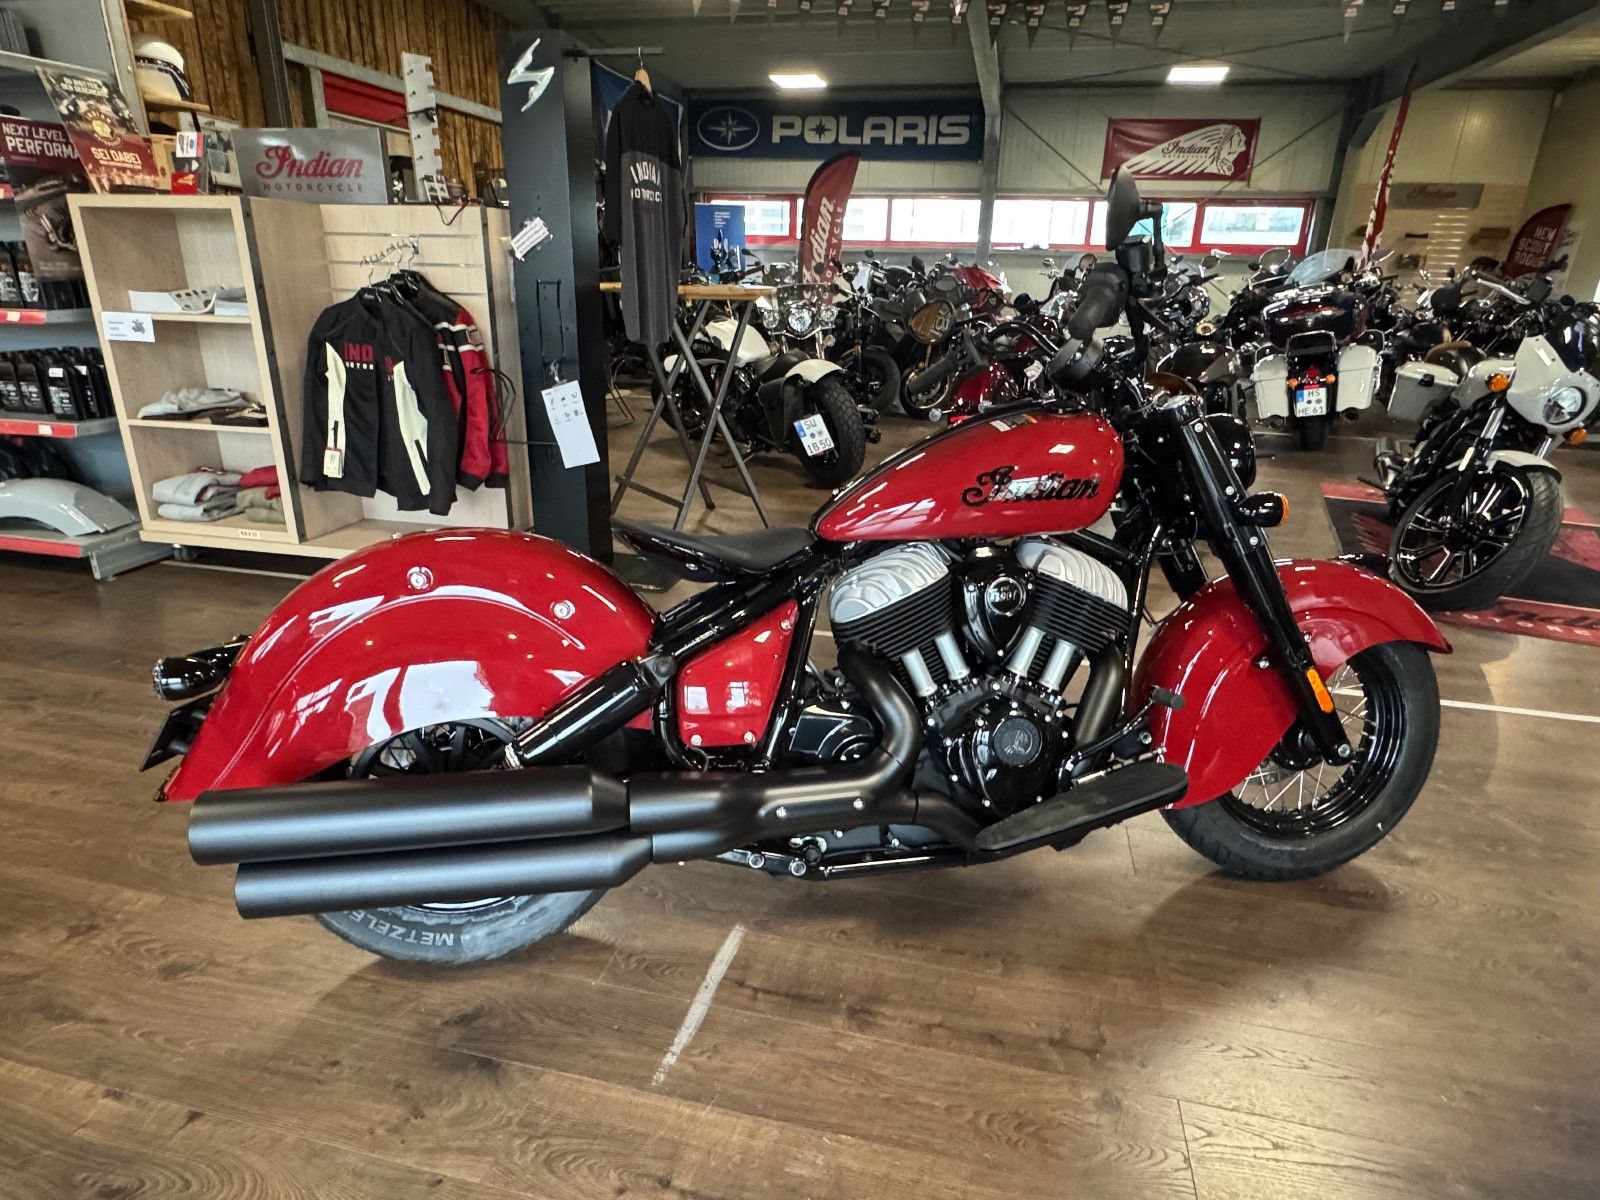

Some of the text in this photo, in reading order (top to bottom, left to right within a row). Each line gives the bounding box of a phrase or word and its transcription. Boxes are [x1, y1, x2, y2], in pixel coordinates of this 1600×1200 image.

[2, 122, 66, 142] NEXT LEVEL
[771, 114, 970, 145] POLARIS
[90, 146, 111, 160] SEI
[111, 150, 143, 165] DABEI
[1161, 141, 1211, 155] Indian
[256, 145, 363, 179] Indian
[263, 182, 364, 193] MOTORCYCLE
[803, 418, 817, 430] SU
[819, 437, 832, 450] 50
[961, 466, 1099, 507] Indian
[343, 909, 454, 945] METZELE
